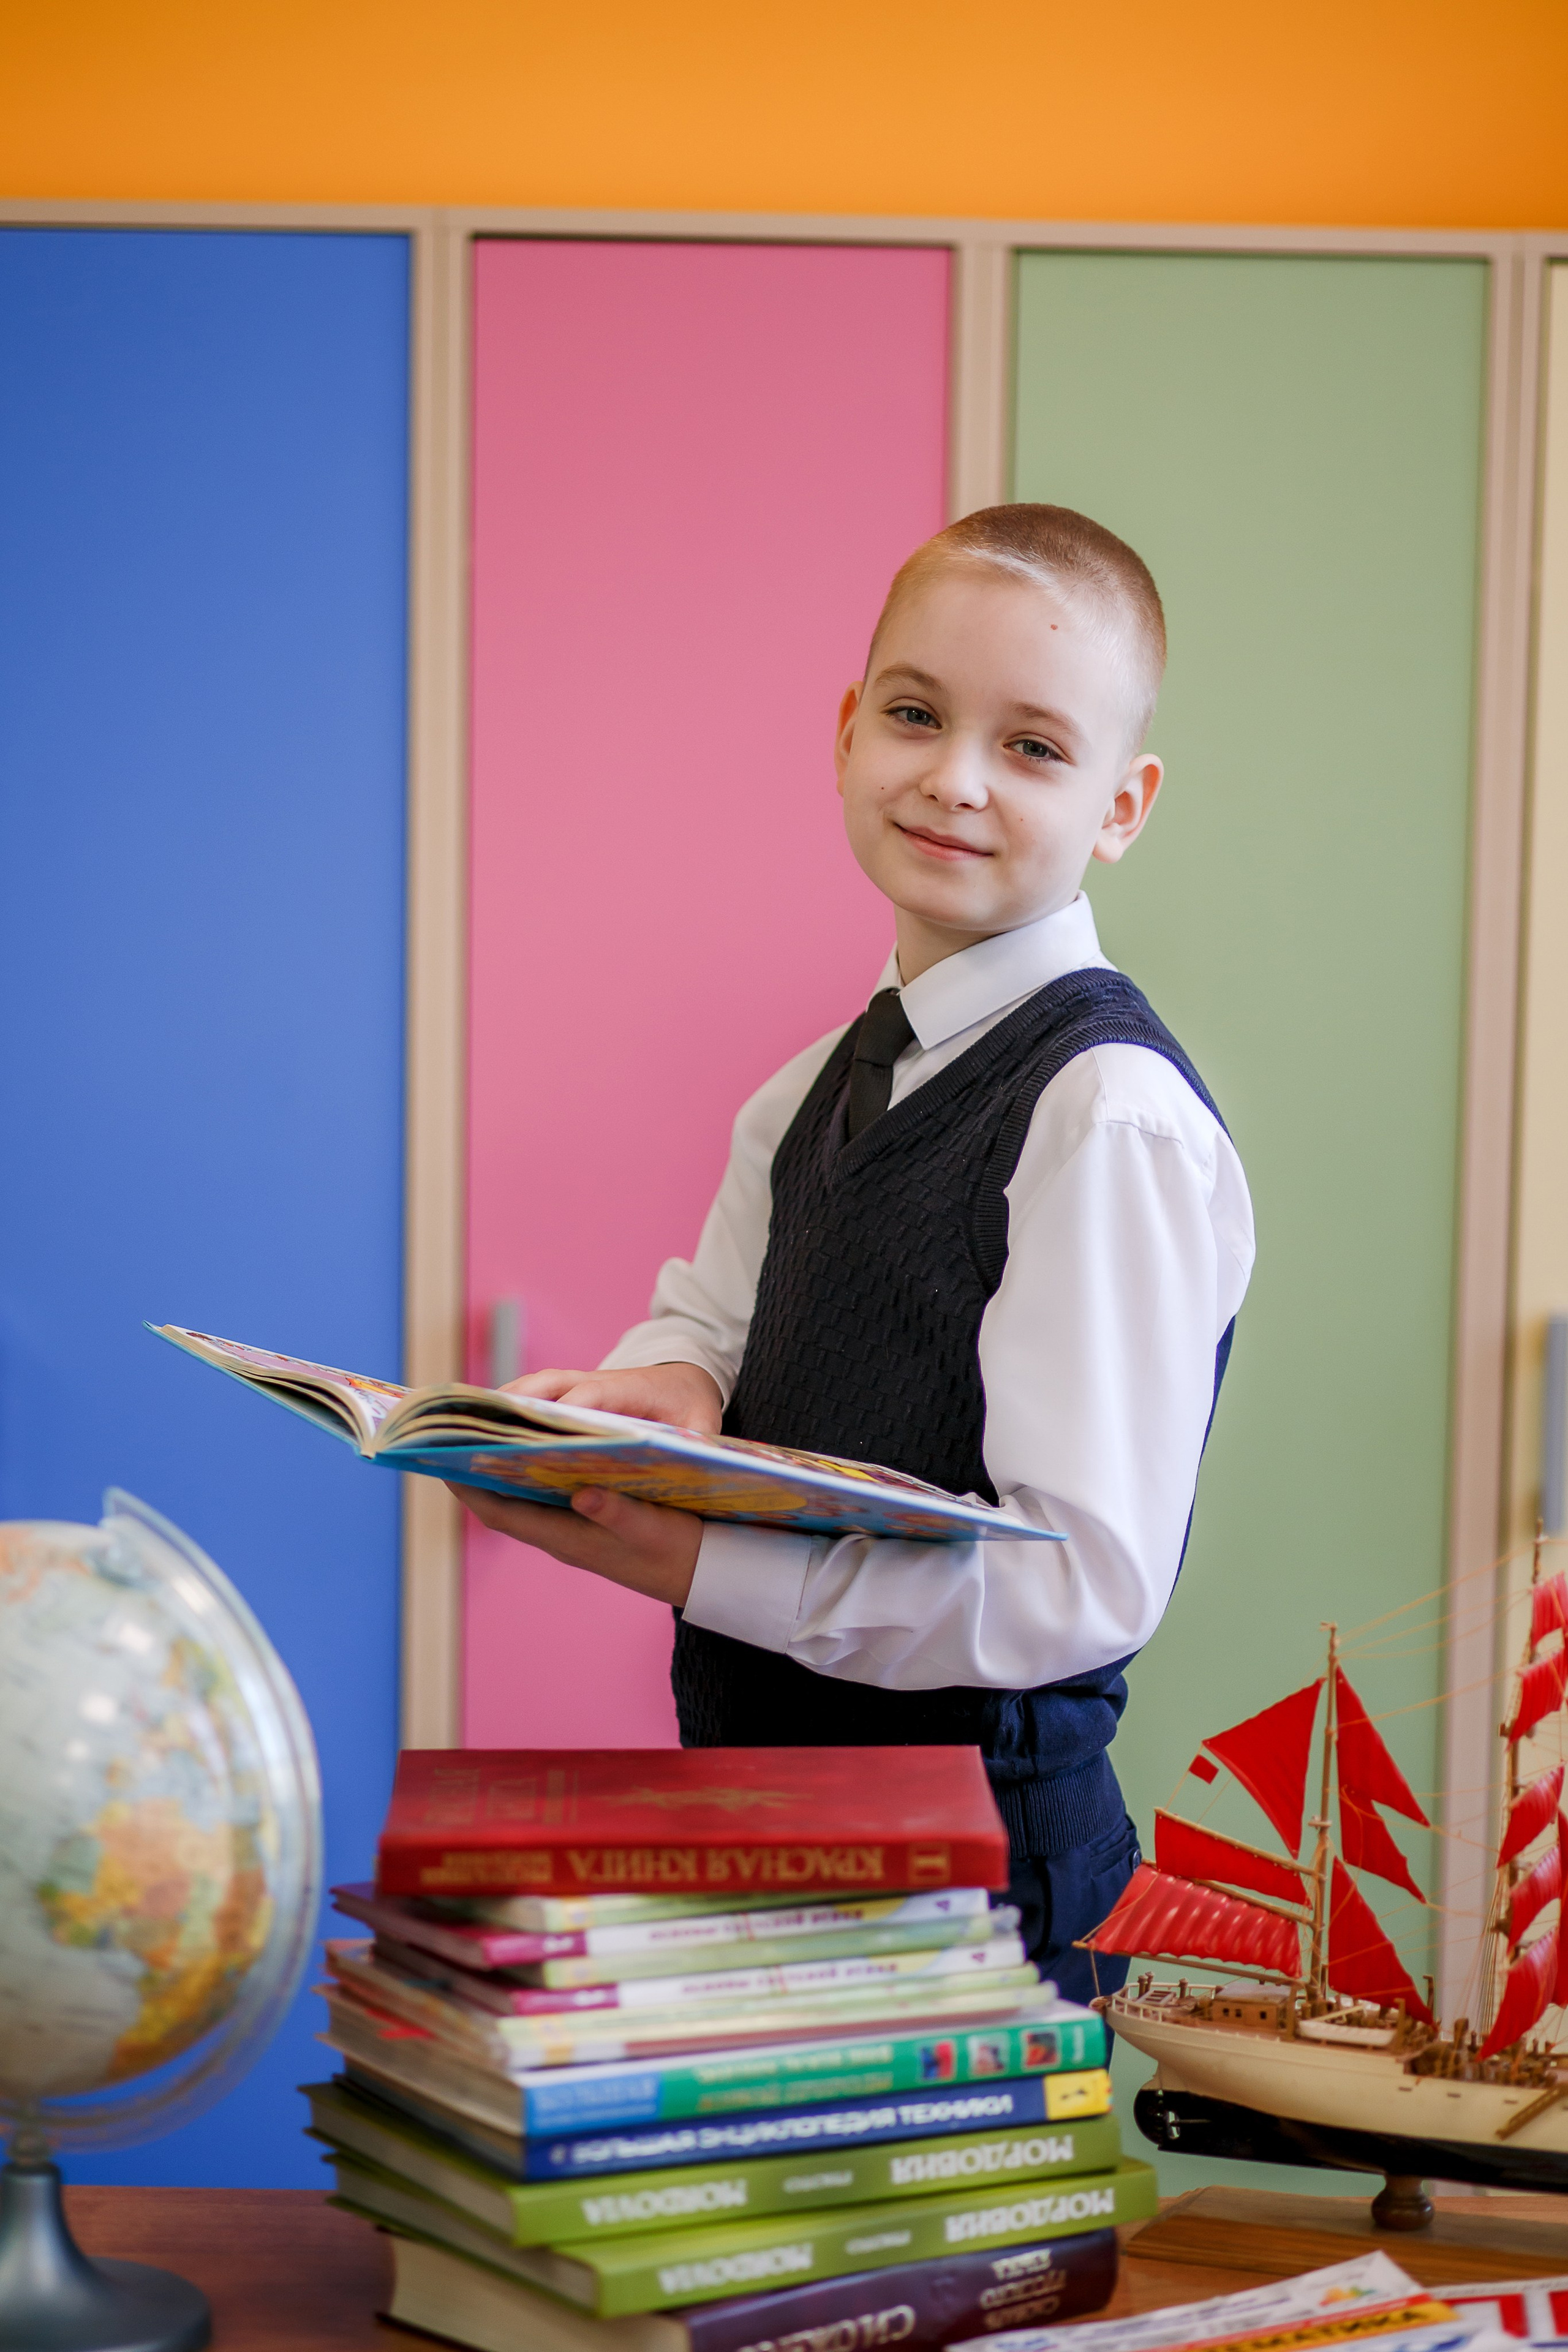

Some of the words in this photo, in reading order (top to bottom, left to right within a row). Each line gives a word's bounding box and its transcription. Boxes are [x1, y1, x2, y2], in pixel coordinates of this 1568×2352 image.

[567, 1847, 698, 1883] КНИГА
[706, 1847, 884, 1882] КРАСНАЯ
[572, 2130, 696, 2163] БОЛЬШАЯ
[698, 2106, 896, 2147] ЭНЦИКЛОПЕДИЯ
[899, 2094, 1013, 2125] ТЕХНИКИ
[890, 2135, 1074, 2184] МОРДОВИЯ
[944, 2188, 1114, 2242] МОРДОВИЯ
